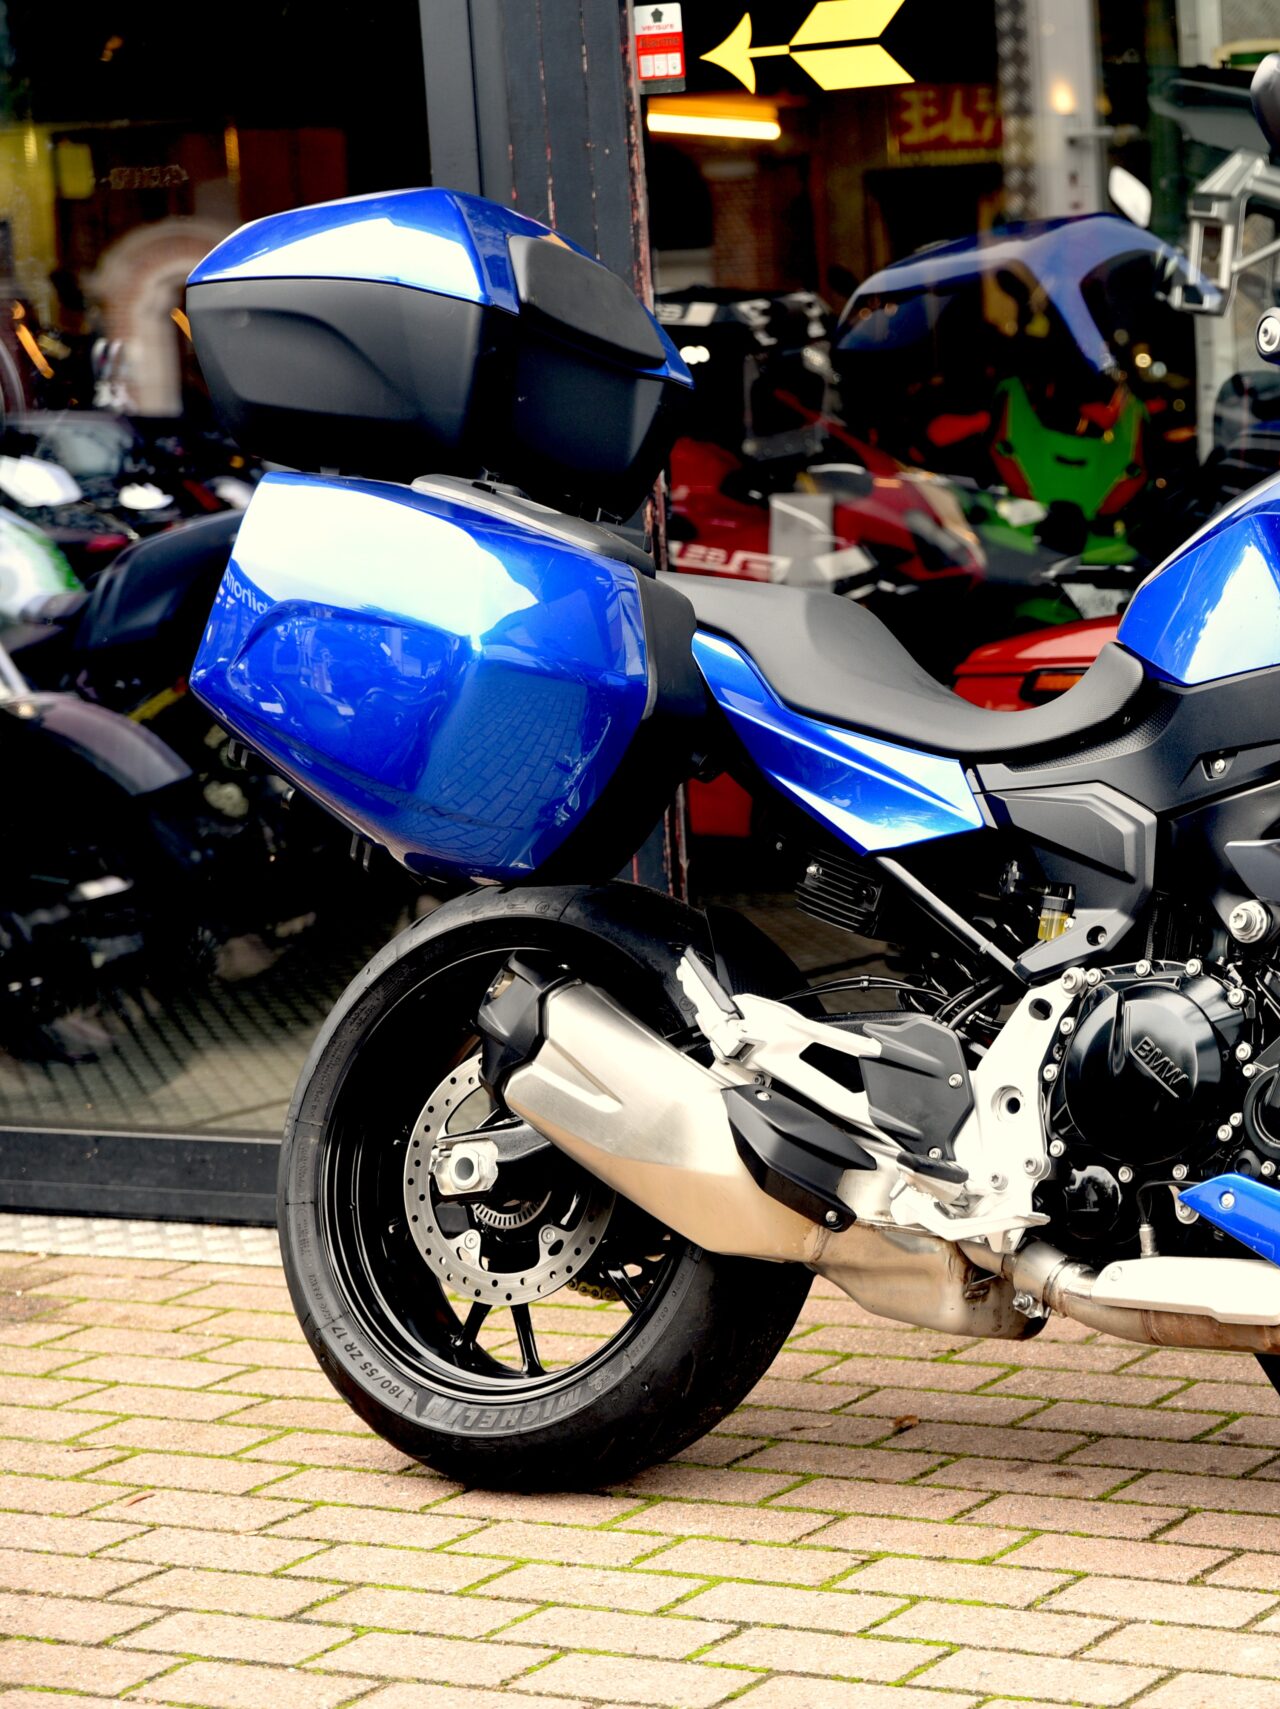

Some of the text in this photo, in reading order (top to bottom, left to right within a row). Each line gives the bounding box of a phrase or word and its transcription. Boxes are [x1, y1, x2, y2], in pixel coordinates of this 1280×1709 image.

[1134, 1036, 1189, 1085] BMW
[332, 1325, 348, 1340] 17
[344, 1342, 364, 1361] ZR
[360, 1361, 405, 1399] 180/55
[422, 1386, 582, 1430] MICHELIN
